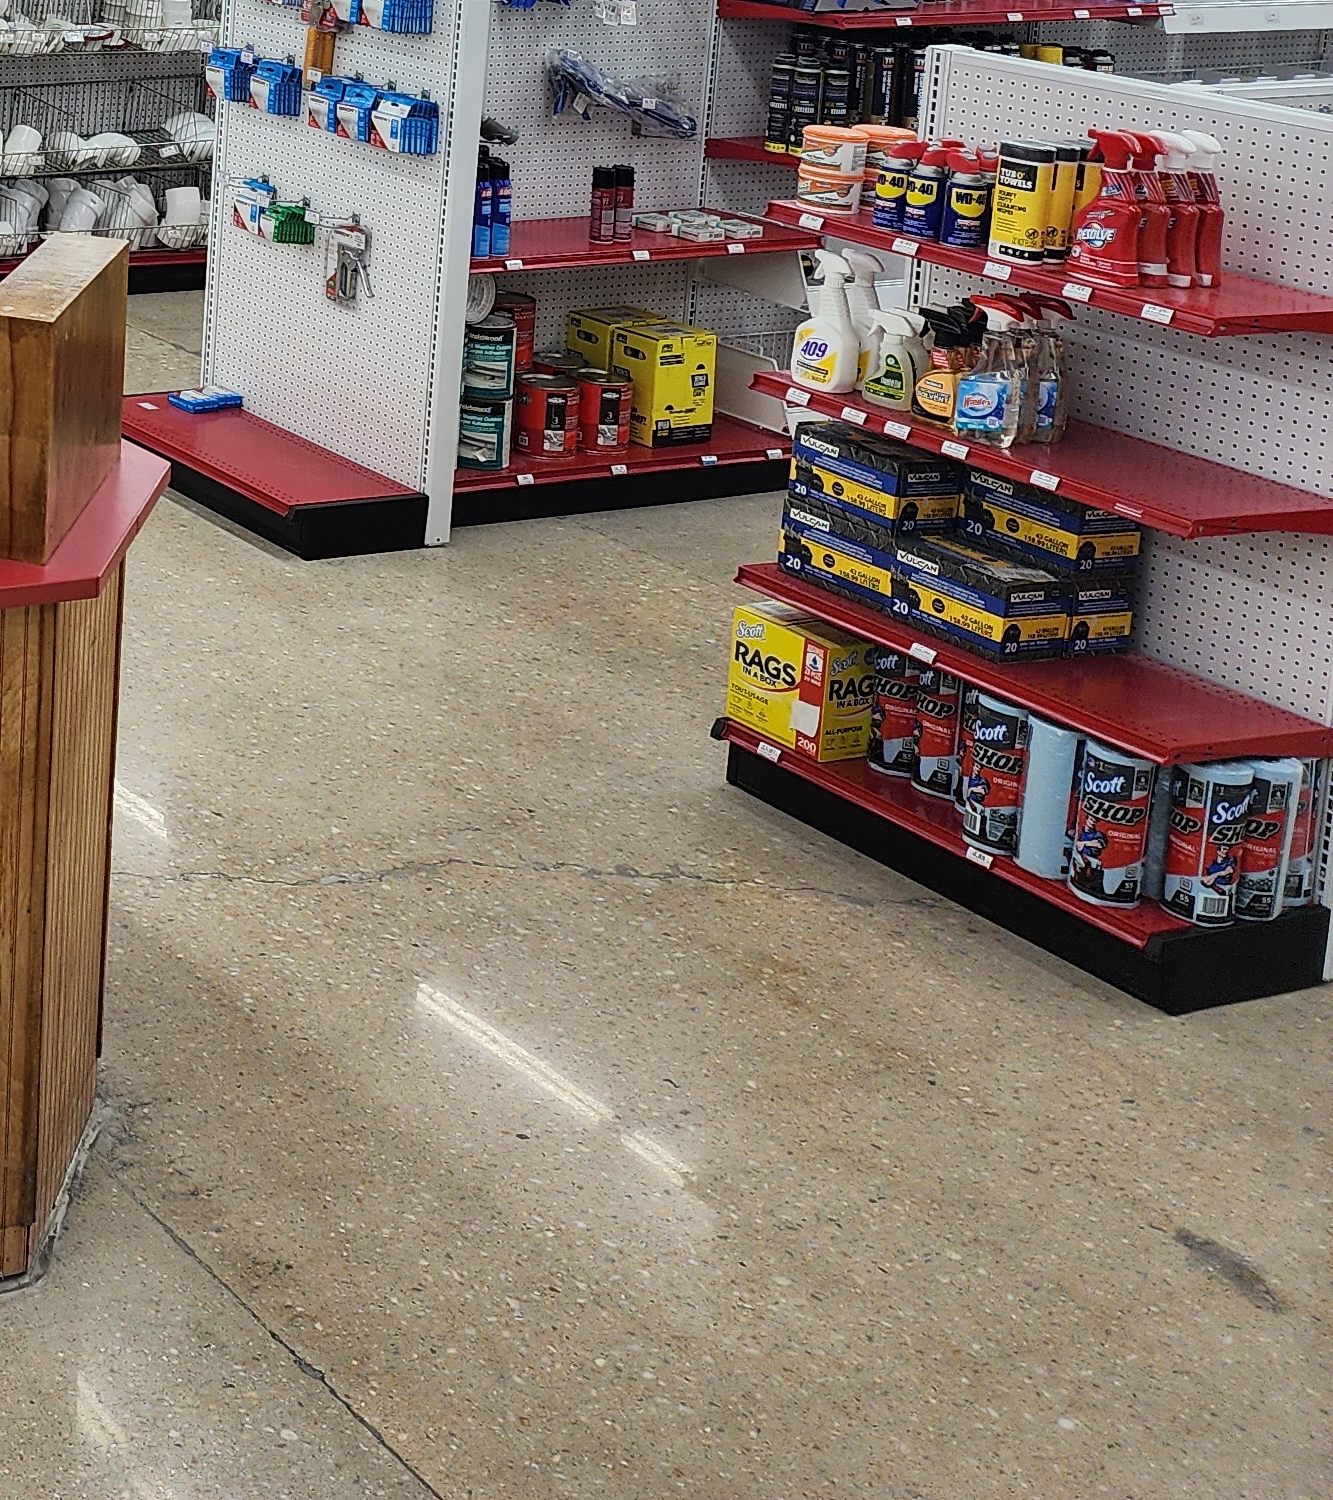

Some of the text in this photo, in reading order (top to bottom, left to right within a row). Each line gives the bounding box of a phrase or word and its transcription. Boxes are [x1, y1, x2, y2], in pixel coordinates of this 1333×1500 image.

[1000, 167, 1017, 179] TUB
[800, 341, 829, 359] 409
[801, 434, 839, 457] VULCAN
[794, 482, 807, 496] 20
[971, 472, 1014, 495] VULCAN
[790, 508, 830, 532] VULCAN
[901, 520, 914, 531] 20
[966, 519, 982, 536] 20
[785, 555, 801, 571] 20
[896, 550, 940, 575] VULCAN
[1080, 559, 1092, 570] 20
[1011, 591, 1044, 602] VULCAN
[1079, 590, 1112, 601] VULCAN
[893, 599, 909, 615] 20
[736, 620, 765, 638] Scott
[1004, 642, 1018, 653] 20
[1075, 640, 1087, 650] 20
[735, 640, 797, 687] RAGS
[830, 651, 858, 676] Scott
[876, 654, 899, 670] cott
[742, 665, 778, 688] IN A BOX
[828, 674, 875, 702] RAG
[876, 677, 919, 701] HOP
[852, 697, 871, 709] BOX
[919, 697, 955, 718] HOP
[973, 719, 1008, 742] Scott
[797, 736, 818, 752] 200
[973, 744, 1024, 774] SHOP
[992, 776, 1018, 788] ORIGIN
[1084, 770, 1126, 795] Scott
[1084, 797, 1146, 826] SHOP
